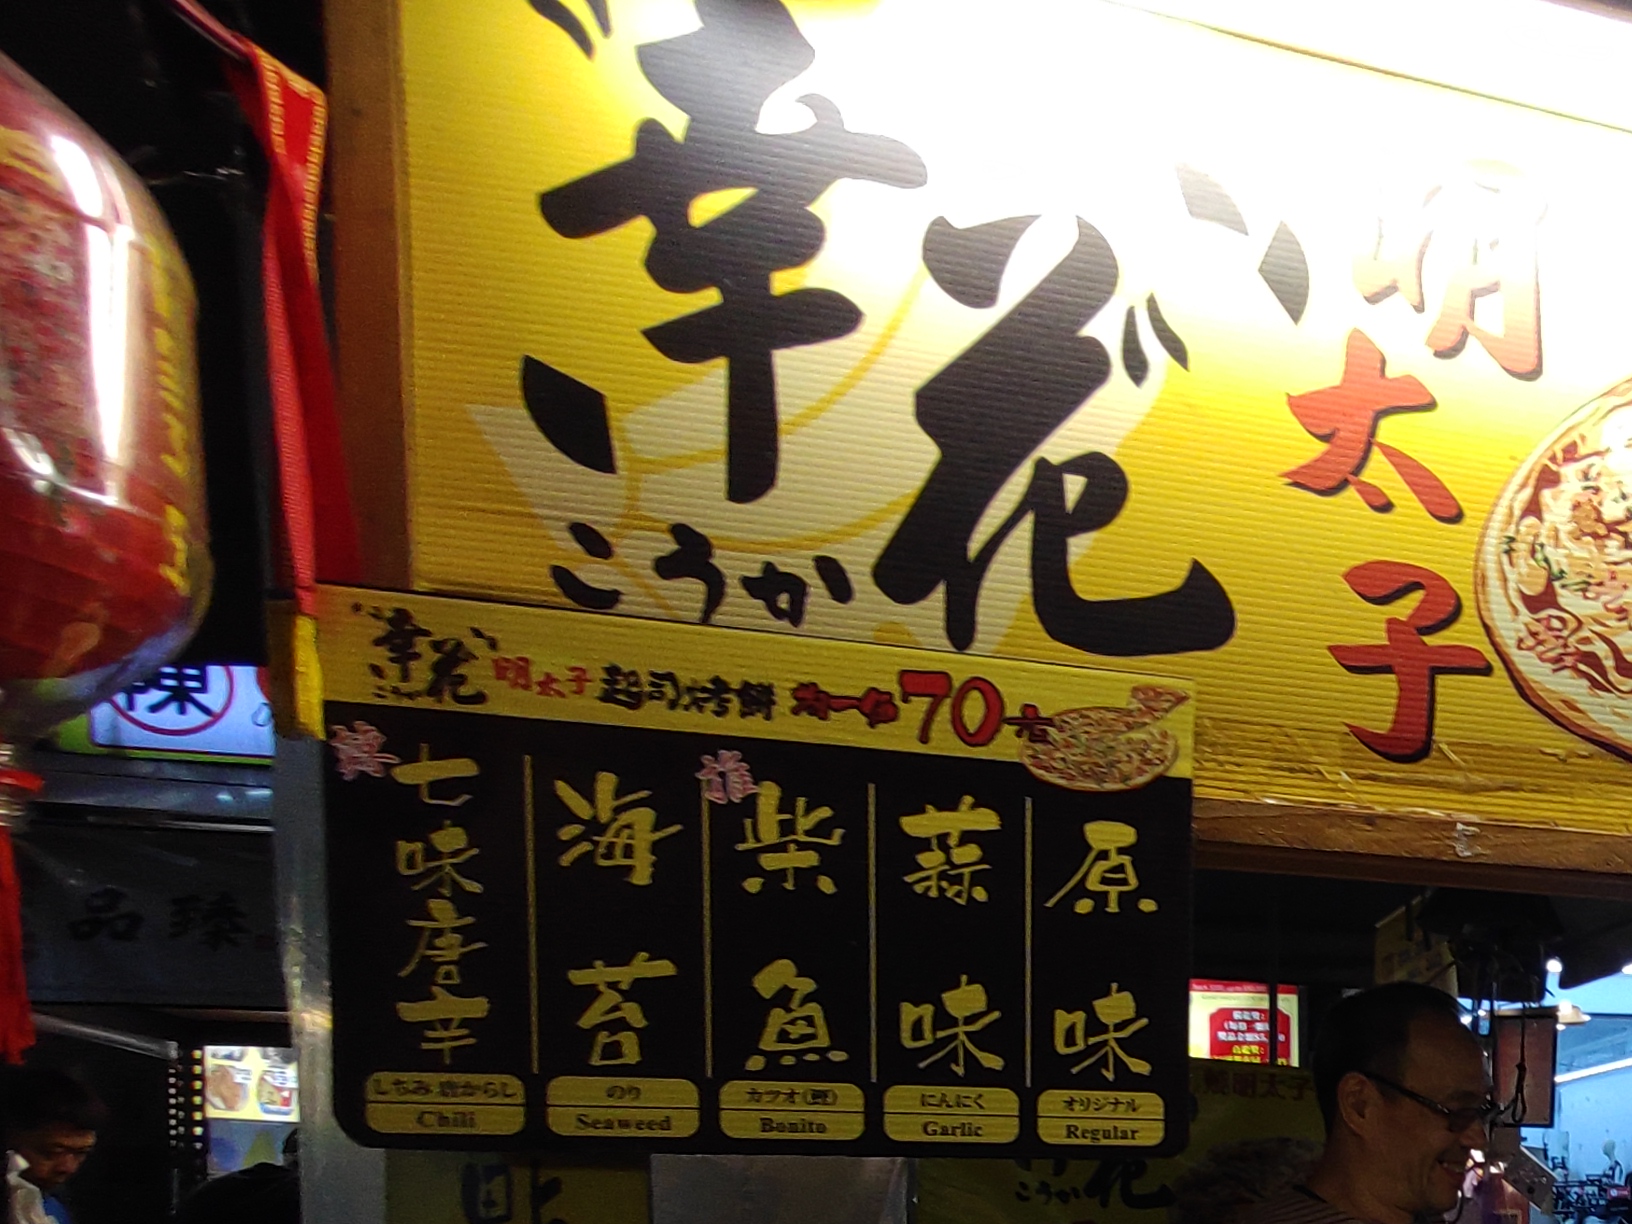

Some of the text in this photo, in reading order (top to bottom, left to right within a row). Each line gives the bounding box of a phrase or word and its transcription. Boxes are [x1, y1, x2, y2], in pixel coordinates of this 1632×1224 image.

[1280, 165, 1548, 765] 明太子
[550, 520, 856, 630] こうか
[553, 771, 684, 1067] 海苔
[734, 781, 849, 1071] 柴魚
[898, 795, 1006, 1080] 蒜味
[1043, 818, 1160, 1082] 原味
[606, 1084, 642, 1101] のり
[920, 1091, 985, 1111] にんにく
[1062, 1096, 1139, 1115] オリジナル
[416, 1110, 477, 1129] Chili
[575, 1113, 672, 1132] Seaweed
[758, 1116, 828, 1136] Bonito
[921, 1119, 985, 1139] Garlic
[1065, 1124, 1140, 1145] Regular
